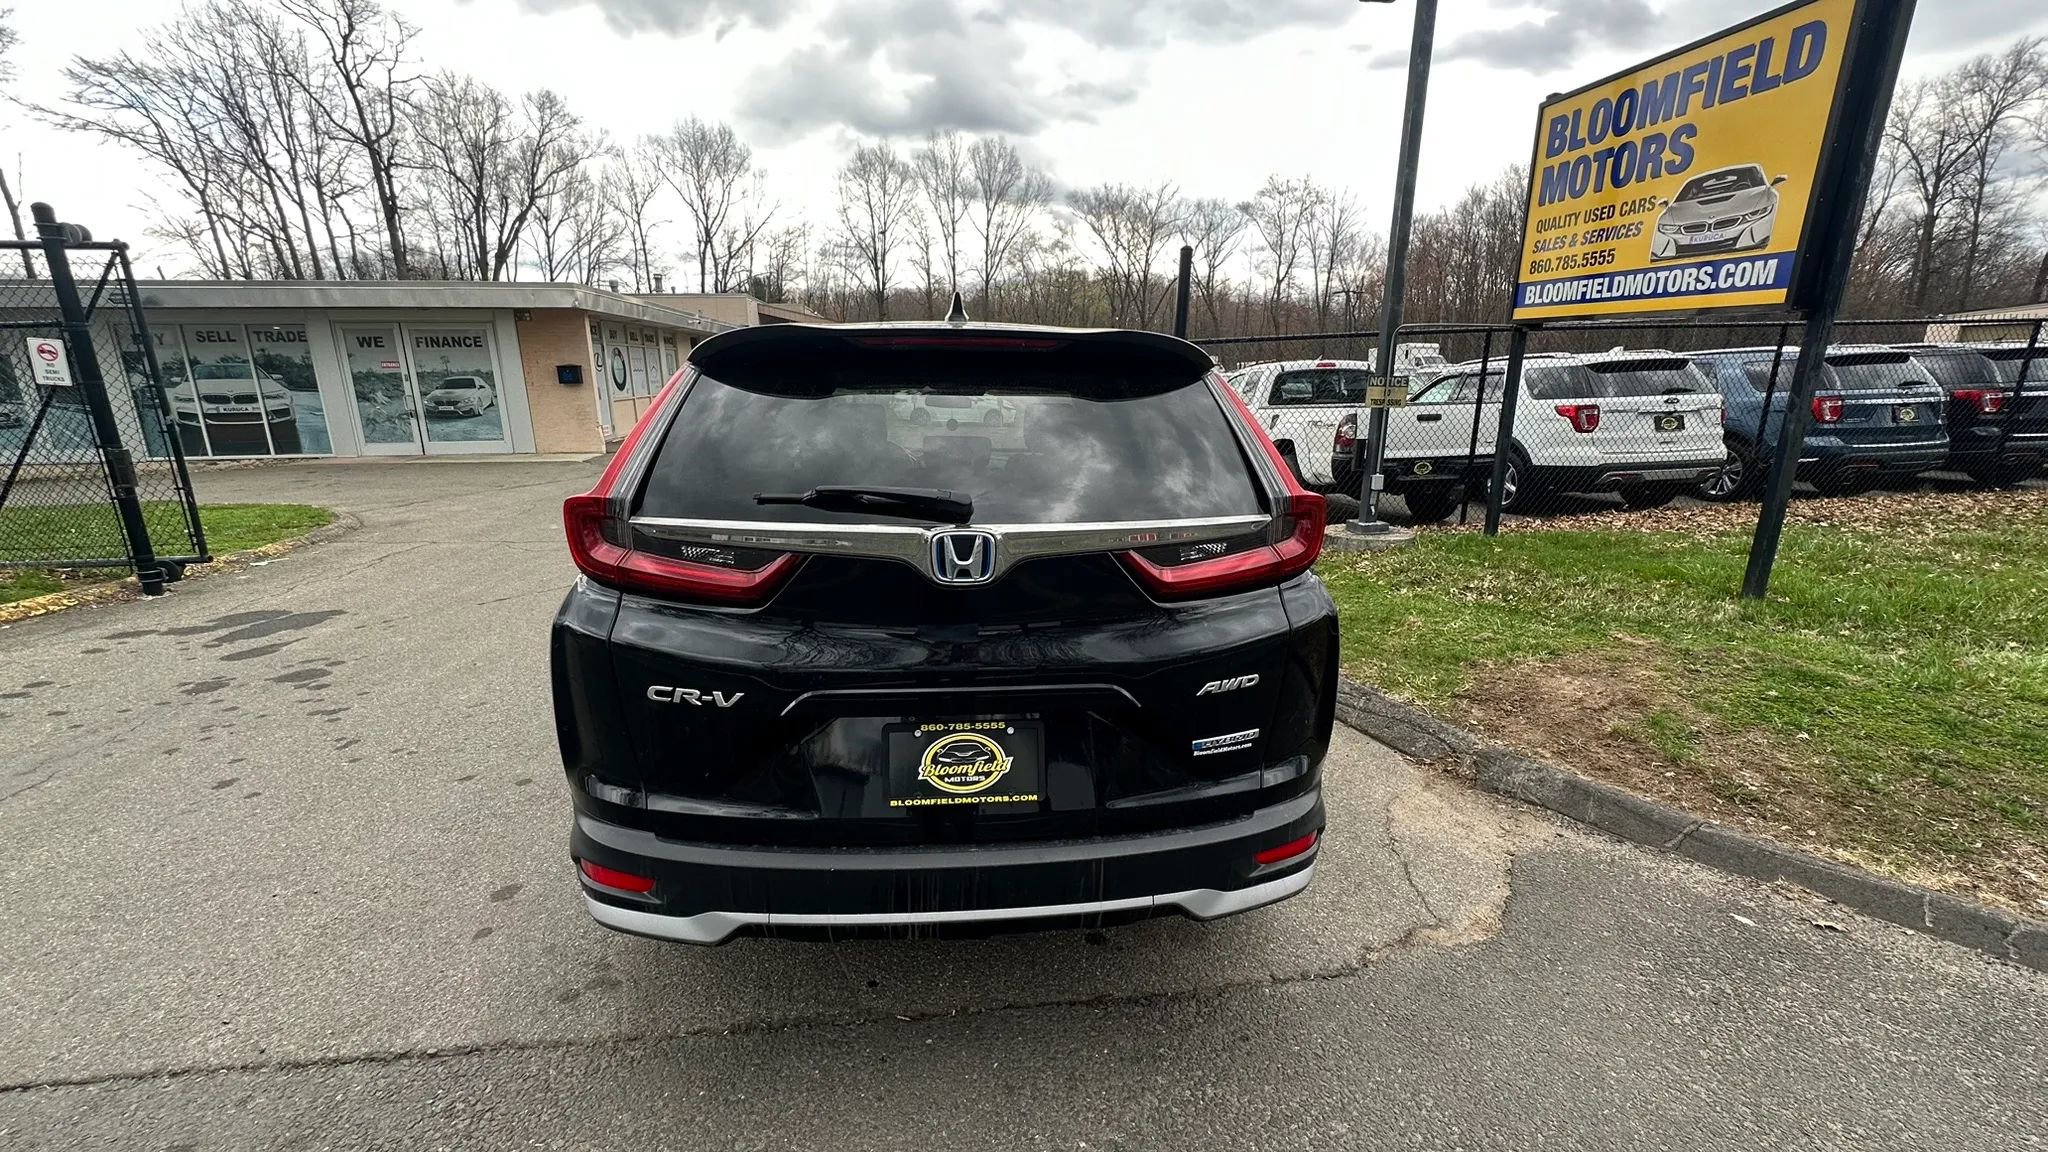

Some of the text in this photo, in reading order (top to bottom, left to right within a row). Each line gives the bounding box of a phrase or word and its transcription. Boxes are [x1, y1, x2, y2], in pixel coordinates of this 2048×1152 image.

[1545, 19, 1828, 159] BLOOMFIELD
[1537, 122, 1698, 208] MOTORS
[1536, 196, 1657, 234] QUALITY USED CARS
[1532, 221, 1644, 254] SALES & SERVICES
[1529, 248, 1616, 275] 860.785.5555
[1525, 259, 1778, 305] BLOOMFIELDMOTORS.COM
[195, 330, 237, 343] SELL
[252, 330, 308, 343] TRADE
[356, 336, 484, 348] WE FINANCE
[1196, 673, 1260, 696] AWD
[646, 685, 745, 708] CR-V
[920, 722, 1006, 731] 860-785-5555
[923, 759, 1009, 777] Bloomfield
[944, 775, 986, 783] MOTORS
[890, 794, 1038, 806] BLOOMFIELDMOTORS.COM
